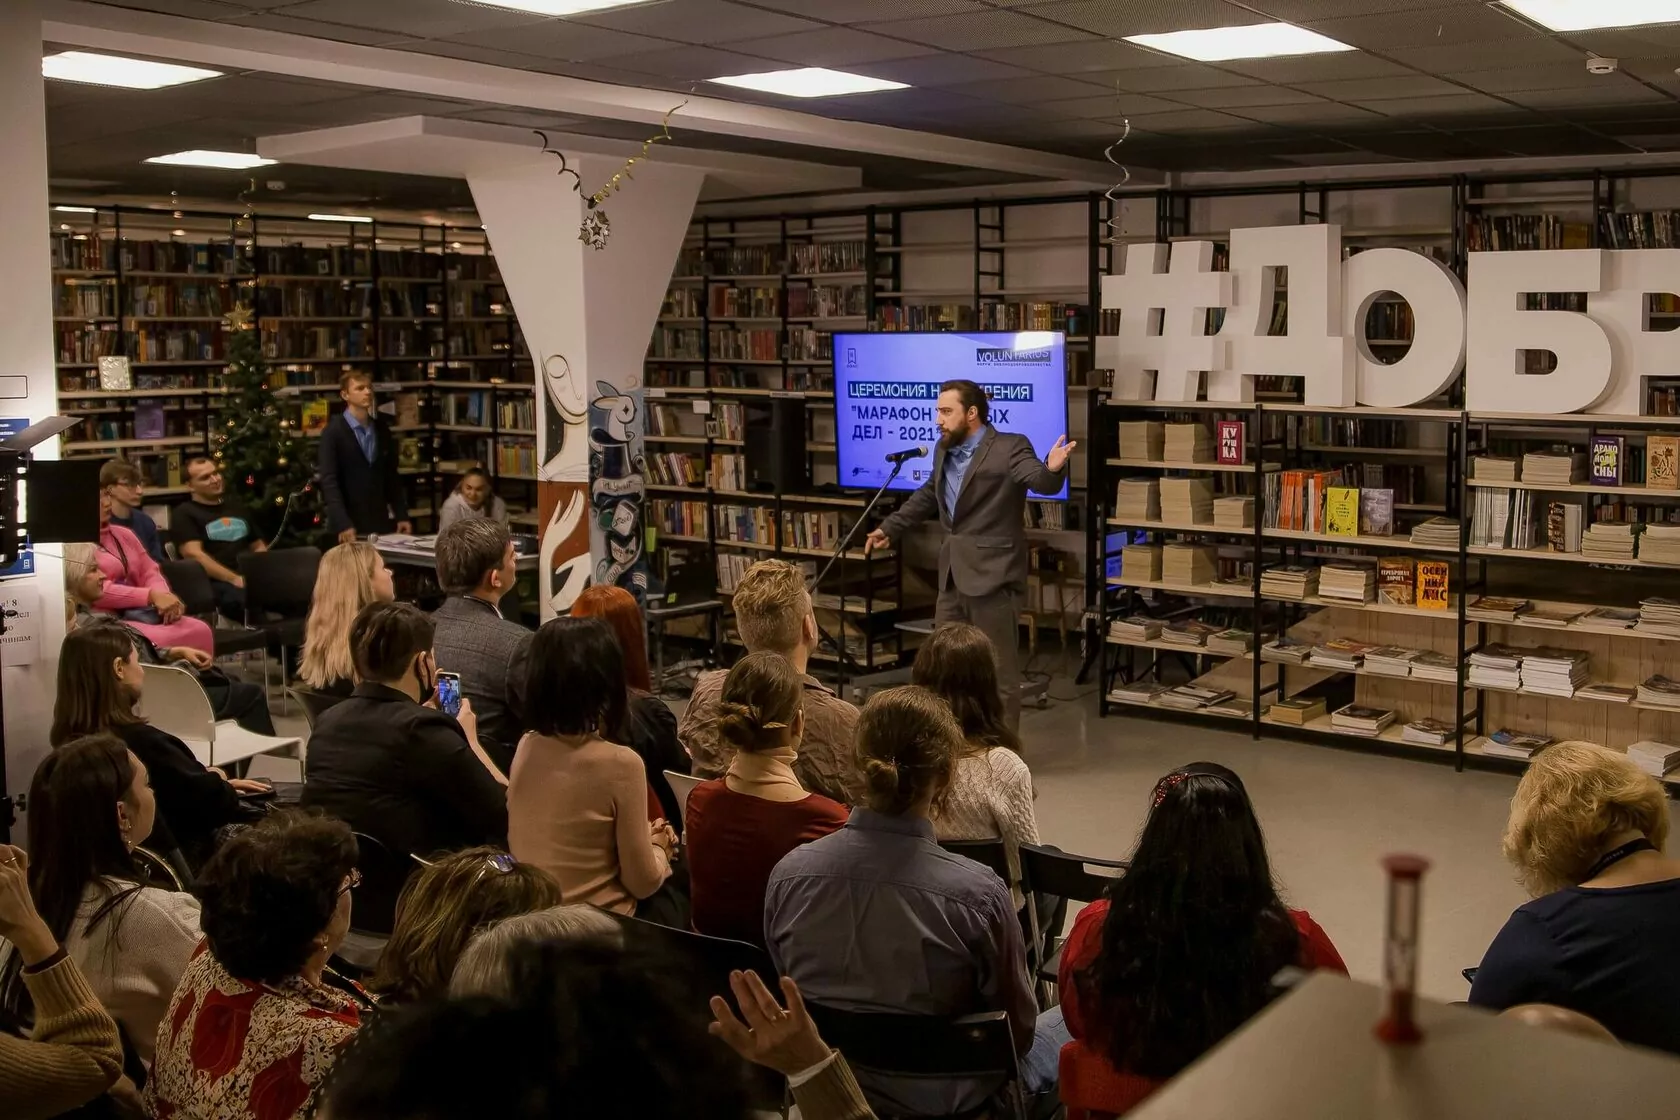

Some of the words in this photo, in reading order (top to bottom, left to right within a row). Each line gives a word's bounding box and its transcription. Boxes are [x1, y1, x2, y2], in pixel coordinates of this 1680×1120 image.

[850, 384, 926, 397] ЦЕРЕМОНИЯ
[851, 405, 932, 421] "МАРАФОН
[851, 425, 883, 441] ДЕЛ
[1222, 427, 1237, 438] КУ
[1222, 447, 1237, 458] КА
[1593, 466, 1617, 478] СНЫ
[1422, 566, 1447, 576] ОСЕН
